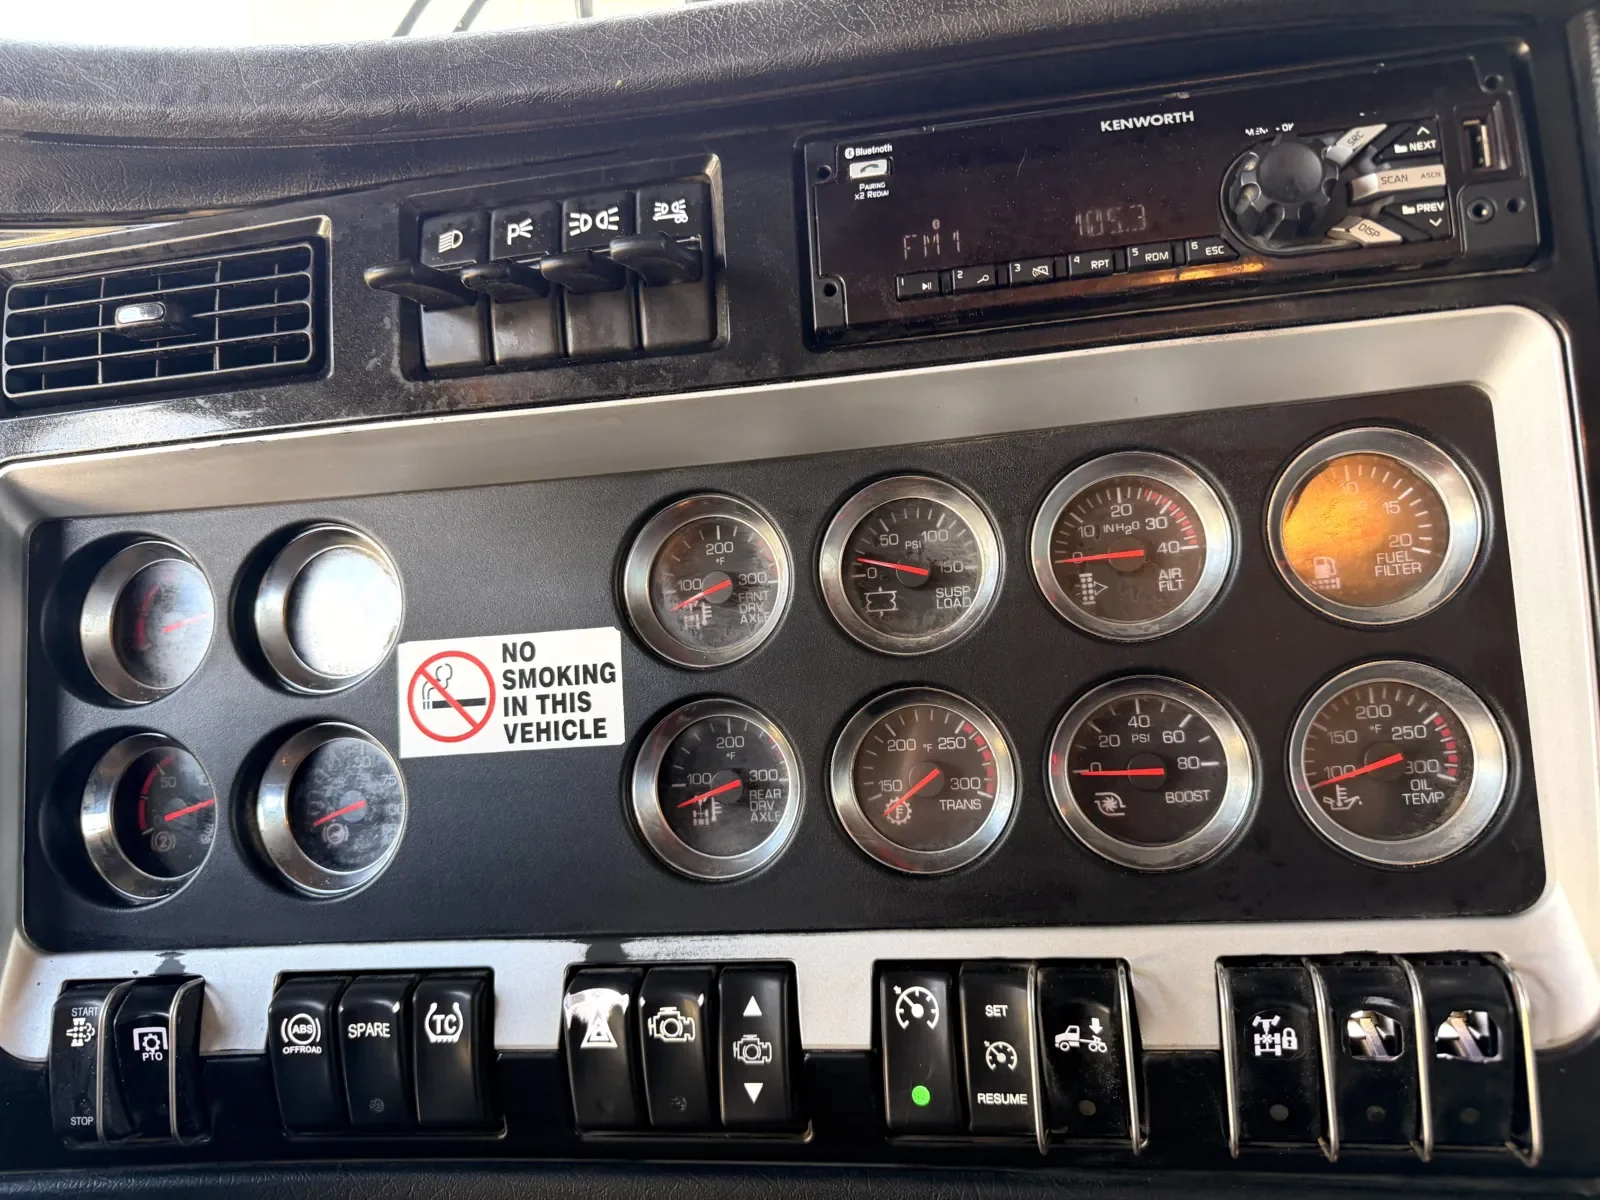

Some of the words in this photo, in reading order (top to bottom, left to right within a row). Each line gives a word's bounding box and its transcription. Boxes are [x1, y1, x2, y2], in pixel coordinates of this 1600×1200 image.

[1100, 111, 1195, 132] KENWORTH
[1347, 131, 1364, 147] SRC
[1409, 140, 1436, 152] NEXT
[1380, 174, 1408, 185] SCAN
[1416, 202, 1445, 213] PREV
[1358, 223, 1381, 238] DISP
[1131, 247, 1139, 257] 5
[1145, 251, 1169, 262] RDM
[1191, 241, 1199, 251] 6
[1205, 245, 1225, 256] ESC
[1014, 263, 1022, 272] 3
[1073, 255, 1081, 264] 4
[1091, 258, 1110, 270] RPT
[957, 270, 964, 280] 2
[1110, 503, 1132, 518] 20
[1382, 501, 1400, 515] 15
[1145, 516, 1168, 530] 30
[921, 529, 949, 543] 100
[1078, 524, 1096, 537] 10
[880, 533, 899, 546] 50
[905, 540, 922, 549] PSI
[1388, 533, 1412, 548] 20
[706, 541, 734, 555] 200
[1157, 540, 1180, 554] 40
[1376, 550, 1414, 565] FUEL
[867, 567, 877, 579] 0
[940, 561, 964, 573] 150
[1158, 568, 1182, 580] AIR
[1374, 562, 1422, 577] FILTER
[679, 578, 702, 591] 100
[739, 572, 767, 585] 300
[1158, 578, 1185, 592] FILT
[935, 585, 971, 598] SUSP
[936, 597, 972, 609] LOAD
[502, 641, 536, 663] NO
[502, 662, 616, 691] SMOKING
[503, 695, 528, 717] IN
[536, 691, 592, 715] THIS
[1355, 704, 1392, 720] 200
[1127, 714, 1150, 729] 40
[503, 717, 608, 744] VEHICLE
[1162, 730, 1185, 744] 60
[1327, 729, 1358, 745] 150
[1391, 724, 1427, 741] 250
[716, 735, 745, 749] 200
[887, 738, 917, 752] 200
[937, 736, 967, 750] 250
[1098, 734, 1121, 748] 20
[1131, 734, 1150, 744] PSI
[1177, 756, 1200, 770] 80
[1404, 759, 1439, 775] 300
[686, 772, 712, 785] 100
[749, 768, 779, 782] 300
[1323, 764, 1356, 780] 100
[878, 779, 903, 792] 150
[950, 777, 981, 790] 300
[1410, 778, 1433, 791] OIL
[749, 789, 782, 800] REAR
[1165, 789, 1211, 804] BOOST
[1401, 791, 1446, 806] TEMP
[750, 800, 775, 811] DRV
[939, 799, 982, 811] TRANS
[750, 810, 782, 823] AXLE
[71, 1006, 99, 1018] START
[985, 1004, 1008, 1018] SET
[292, 1023, 314, 1035] ABS
[347, 1022, 391, 1039] SPARE
[432, 1013, 457, 1035] TC
[142, 1051, 163, 1061] PTO
[282, 1045, 322, 1055] OFFROAD
[977, 1092, 1028, 1106] RESUME
[70, 1116, 94, 1127] STOP
